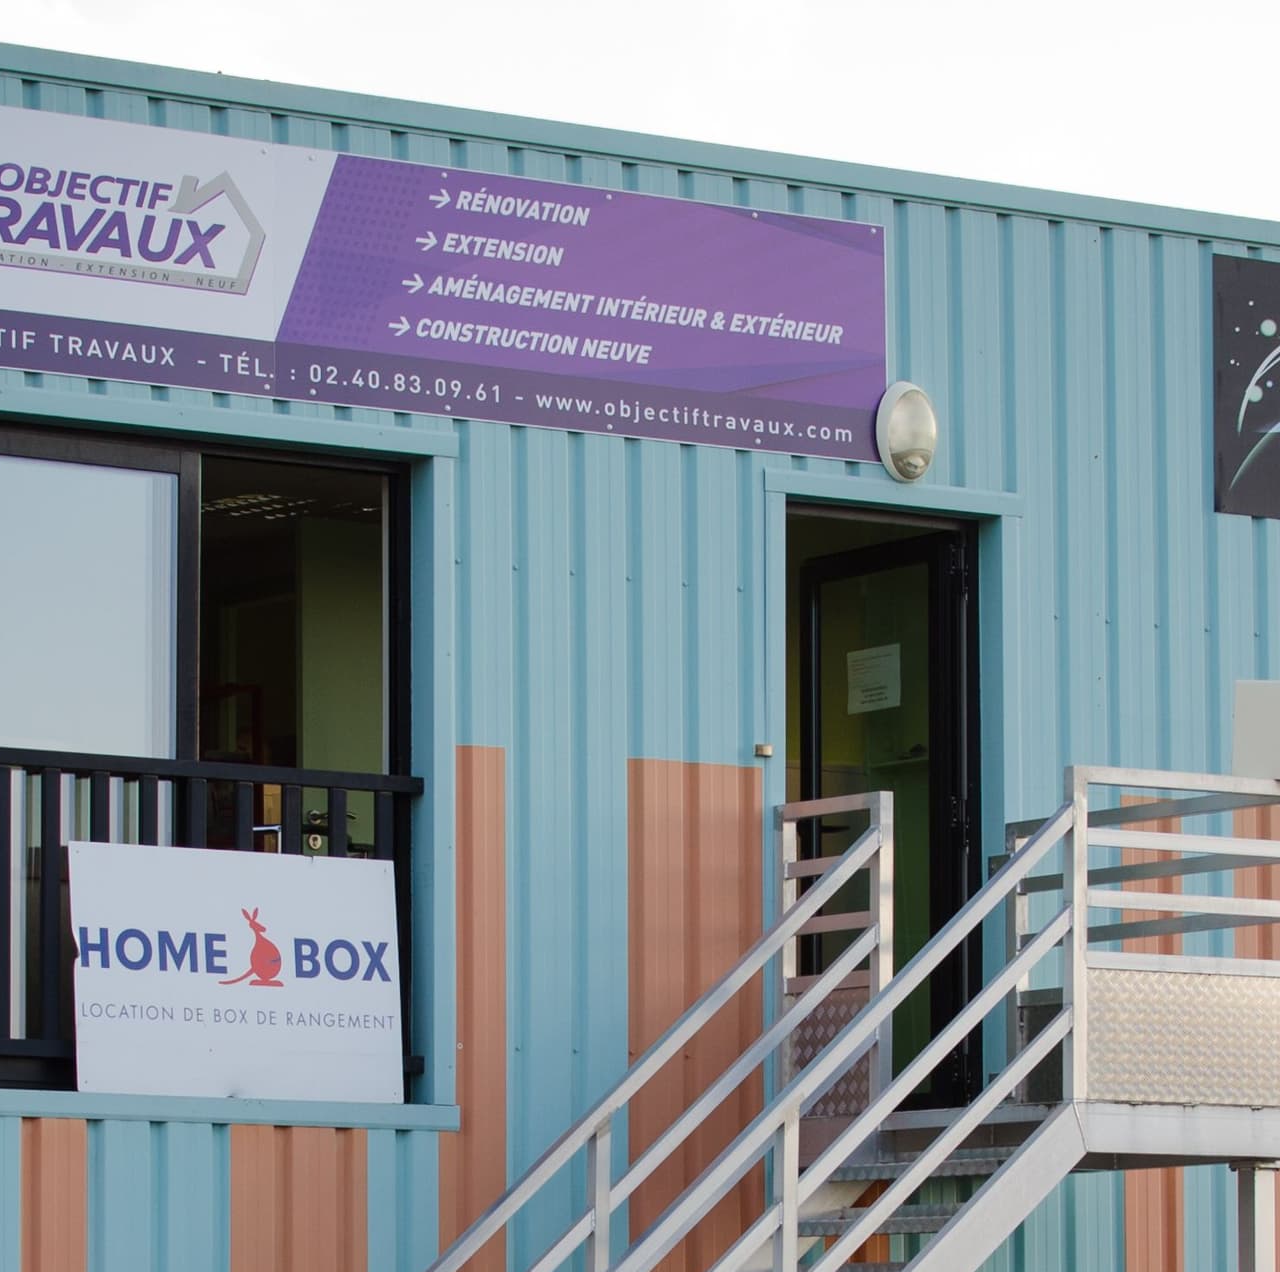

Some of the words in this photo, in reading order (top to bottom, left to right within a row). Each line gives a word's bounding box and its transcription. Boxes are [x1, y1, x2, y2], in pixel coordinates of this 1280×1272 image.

[456, 187, 590, 227] RÉNOVATION
[443, 233, 564, 266] EXTENSION
[75, 262, 171, 282] EXTENSION
[196, 277, 239, 290] NEUF
[427, 274, 594, 314] AMÉNAGEMENT
[596, 295, 706, 329] INTÉRIEUR
[710, 312, 725, 331] &
[729, 313, 844, 345] EXTÉRIEUR
[416, 318, 578, 356] CONSTRUCTION
[581, 338, 652, 365] NEUVE
[49, 334, 175, 366] TRAVAUX
[219, 350, 275, 380] TÉL.
[309, 364, 502, 403] 02.40.83.09.61
[535, 390, 853, 443] www.objectiftravaux.com
[78, 926, 228, 974] HOME
[293, 937, 392, 982] BOX
[81, 1002, 174, 1020] LOCATION
[183, 1007, 204, 1022] DE
[213, 1008, 248, 1024] BOX
[256, 1010, 277, 1025] DE
[286, 1011, 395, 1031] RANGEMENT
